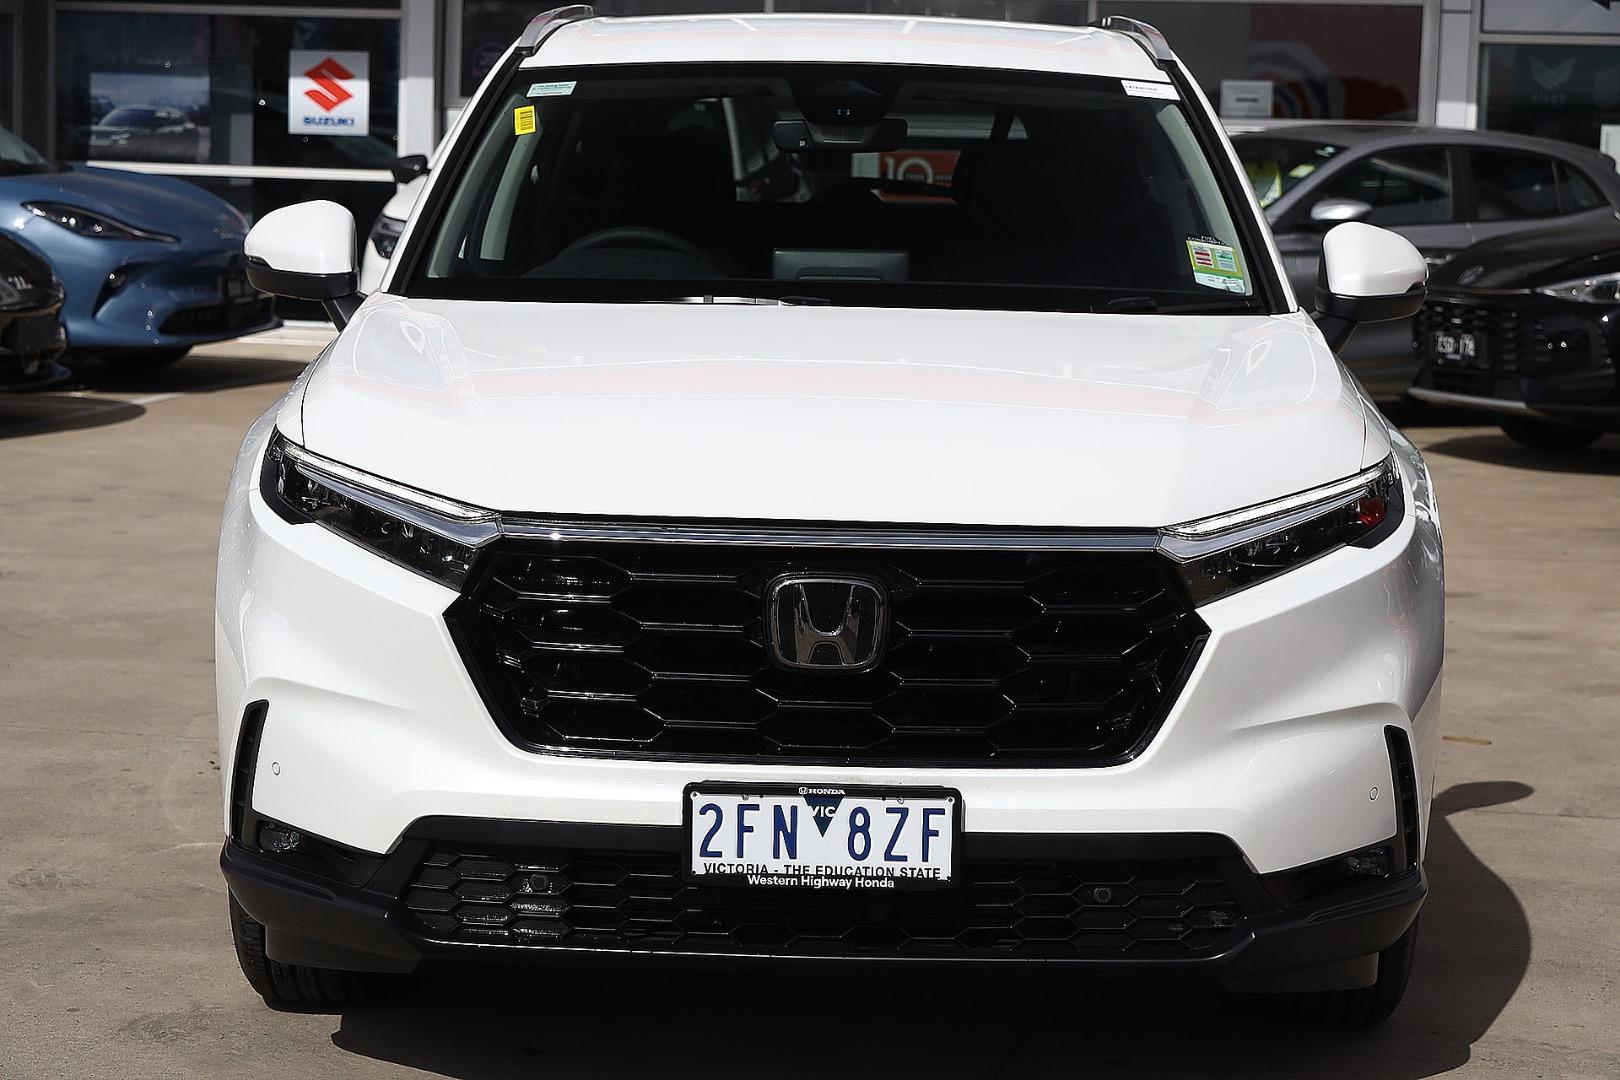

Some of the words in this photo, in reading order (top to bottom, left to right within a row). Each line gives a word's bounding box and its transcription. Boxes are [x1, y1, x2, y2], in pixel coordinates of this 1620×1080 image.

[811, 805, 837, 818] VIC
[699, 802, 798, 860] 2FN
[847, 806, 946, 863] 8ZF
[703, 862, 769, 875] VICTORIA
[784, 864, 811, 876] THE
[815, 865, 895, 878] EDUCATION
[899, 867, 941, 879] STATE
[747, 875, 798, 886] Western
[801, 875, 852, 890] Highway
[855, 877, 895, 888] Honda
